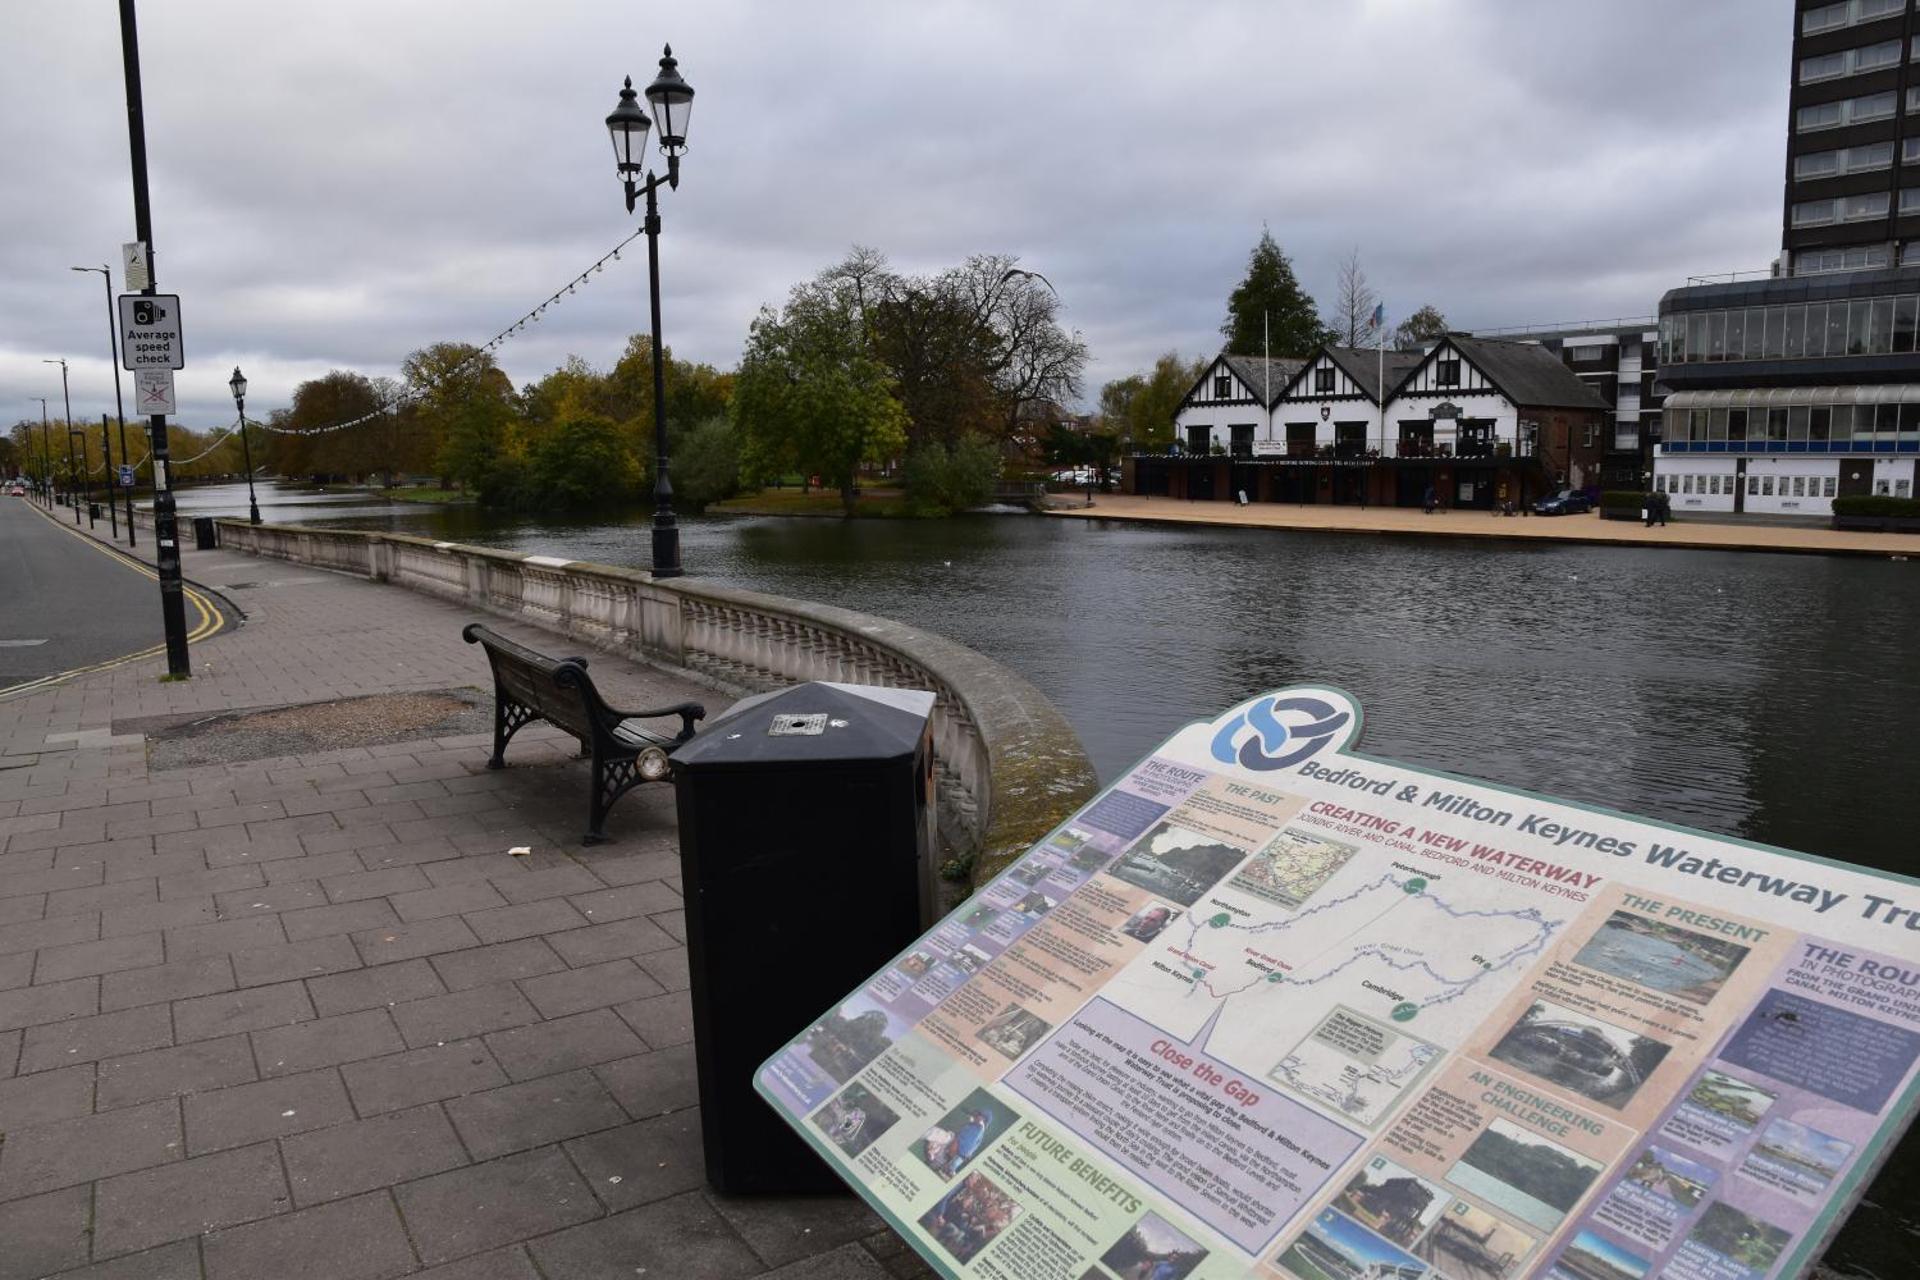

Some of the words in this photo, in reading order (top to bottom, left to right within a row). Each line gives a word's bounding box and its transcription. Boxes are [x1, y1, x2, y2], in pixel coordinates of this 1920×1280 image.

[128, 330, 176, 341] Average
[136, 342, 170, 352] speed
[136, 354, 170, 363] check
[1143, 760, 1169, 772] THE
[1164, 766, 1206, 783] ROUTE
[1222, 782, 1251, 796] THE
[1247, 790, 1285, 805] PAST
[1298, 760, 1403, 799] Bedford
[1395, 784, 1418, 802] &
[1421, 790, 1507, 827] Milton
[1517, 812, 1637, 858] Keynes
[1645, 843, 1848, 913] Waterway
[1306, 800, 1402, 834] CREATING
[1397, 825, 1421, 839] A
[1416, 830, 1468, 852] NEW
[1466, 844, 1603, 890] WATERWAY
[1295, 812, 1336, 828] JOINING
[1332, 823, 1365, 837] RIVER
[1360, 831, 1386, 843] AND
[1382, 837, 1421, 853] CANAL,
[1418, 848, 1471, 868] BEDFORD
[1468, 862, 1497, 876] AND
[1494, 869, 1542, 889] MILTON
[1539, 882, 1590, 903] KEYNES
[1391, 860, 1442, 880] Peterborough
[1210, 898, 1250, 917] Northampton
[1616, 892, 1664, 913] THE
[1663, 906, 1770, 944] PRESENT
[1246, 958, 1274, 974] Bedford
[1472, 954, 1485, 965] Ely
[1800, 959, 1818, 970] IN
[1804, 944, 1856, 968] THE
[1152, 960, 1171, 974] Milton
[1171, 970, 1194, 984] Keynes
[1361, 979, 1404, 1002] Cambridge
[1787, 969, 1820, 982] FROM
[1823, 978, 1846, 990] THE
[1847, 986, 1890, 1003] GRAND
[1828, 990, 1876, 1008] MILTON
[1150, 1040, 1193, 1070] Close
[1193, 1060, 1223, 1086] the
[1224, 1078, 1260, 1106] Gap
[1071, 1018, 1097, 1035] Looking
[1101, 1035, 1114, 1044] the
[1110, 1040, 1128, 1053] map
[1136, 1055, 1154, 1068] easy
[1151, 1063, 1162, 1072] to
[1159, 1068, 1174, 1078] see
[1171, 1075, 1192, 1088] what
[1194, 1088, 1213, 1101] vital
[1209, 1097, 1227, 1110] gap
[1224, 1105, 1240, 1116] the
[1237, 1112, 1270, 1133] Bedford
[1266, 1129, 1278, 1138] &
[1274, 1134, 1303, 1152] Milton
[1298, 1148, 1333, 1171] Keynes
[1122, 1058, 1157, 1080] Waterway
[1154, 1075, 1175, 1089] Trust
[1177, 1089, 1215, 1114] proposing
[1212, 1109, 1223, 1118] to
[1468, 1070, 1494, 1086] AN
[1491, 1080, 1607, 1136] ENGINEERING
[1478, 1090, 1572, 1138] CHALLENGE
[1018, 1121, 1072, 1164] FUTURE
[1068, 1157, 1142, 1214] BENEFITS
